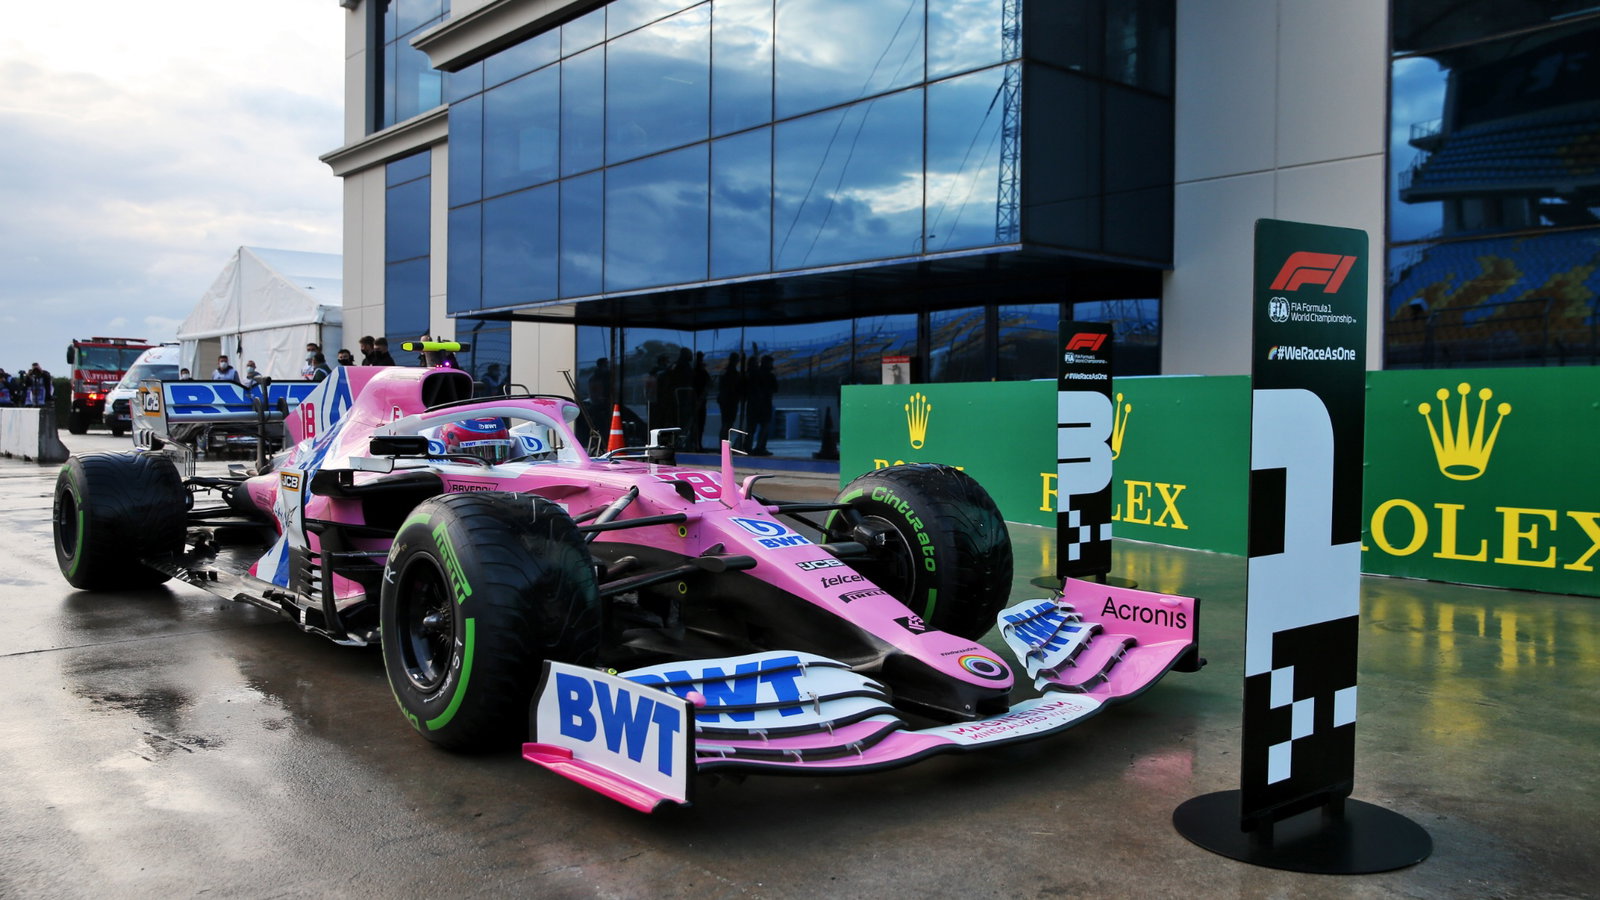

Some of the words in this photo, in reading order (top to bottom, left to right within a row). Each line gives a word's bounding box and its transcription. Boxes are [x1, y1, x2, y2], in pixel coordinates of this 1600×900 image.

[1291, 302, 1302, 311] FIA
[1302, 303, 1328, 312] Formula
[1291, 312, 1310, 322] World
[1311, 314, 1353, 324] Championship
[1277, 346, 1356, 360] #WeRaceAsOne
[301, 402, 316, 440] 18
[1057, 391, 1113, 502] 3
[282, 475, 299, 488] JCB
[1040, 472, 1189, 530] REX
[758, 535, 810, 549] BWT
[872, 486, 936, 572] Cinturato
[432, 521, 472, 605] PIRELLI
[797, 559, 844, 571] JCB
[838, 587, 888, 604] PIRELL
[1101, 596, 1188, 629] Acronis
[555, 672, 682, 778] BWT
[948, 700, 1073, 736] MAGNESIUM
[967, 715, 1049, 741] MINERALIZED
[1048, 704, 1088, 718] WATER
